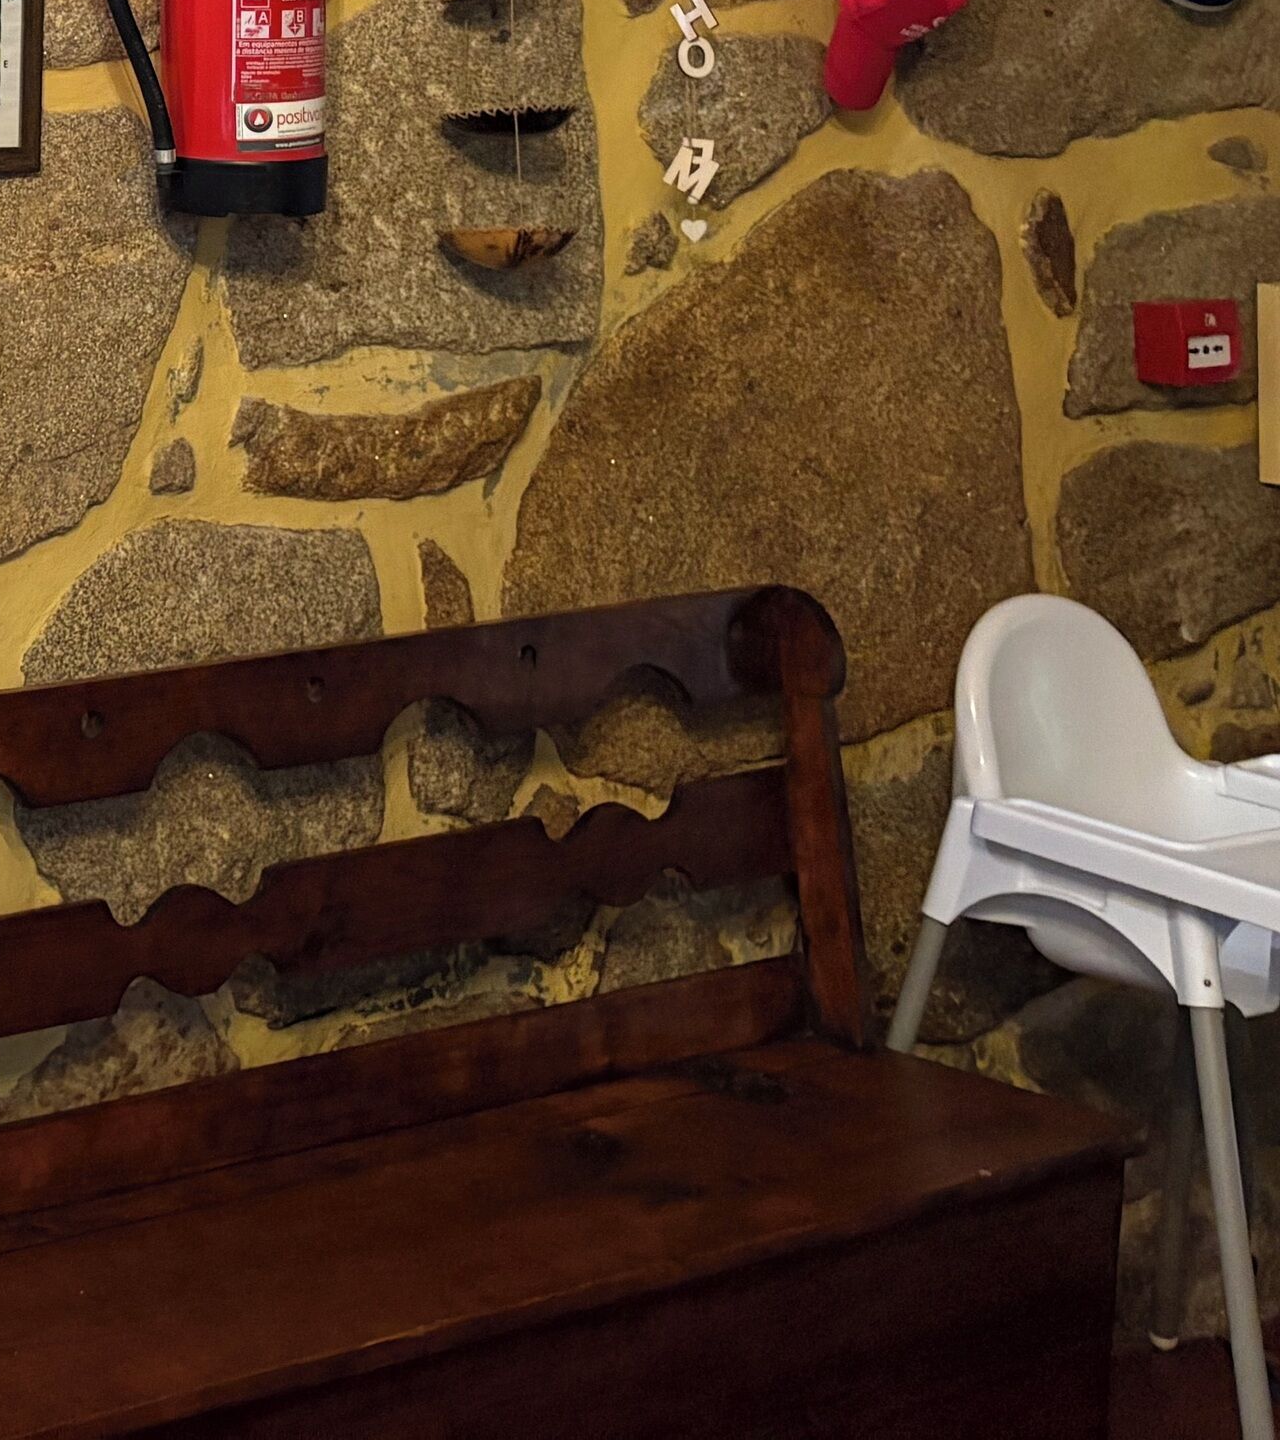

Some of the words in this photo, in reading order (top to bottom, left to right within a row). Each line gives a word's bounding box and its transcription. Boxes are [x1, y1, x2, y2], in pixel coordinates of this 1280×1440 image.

[259, 12, 269, 24] A
[297, 10, 304, 22] B
[3, 60, 8, 68] E
